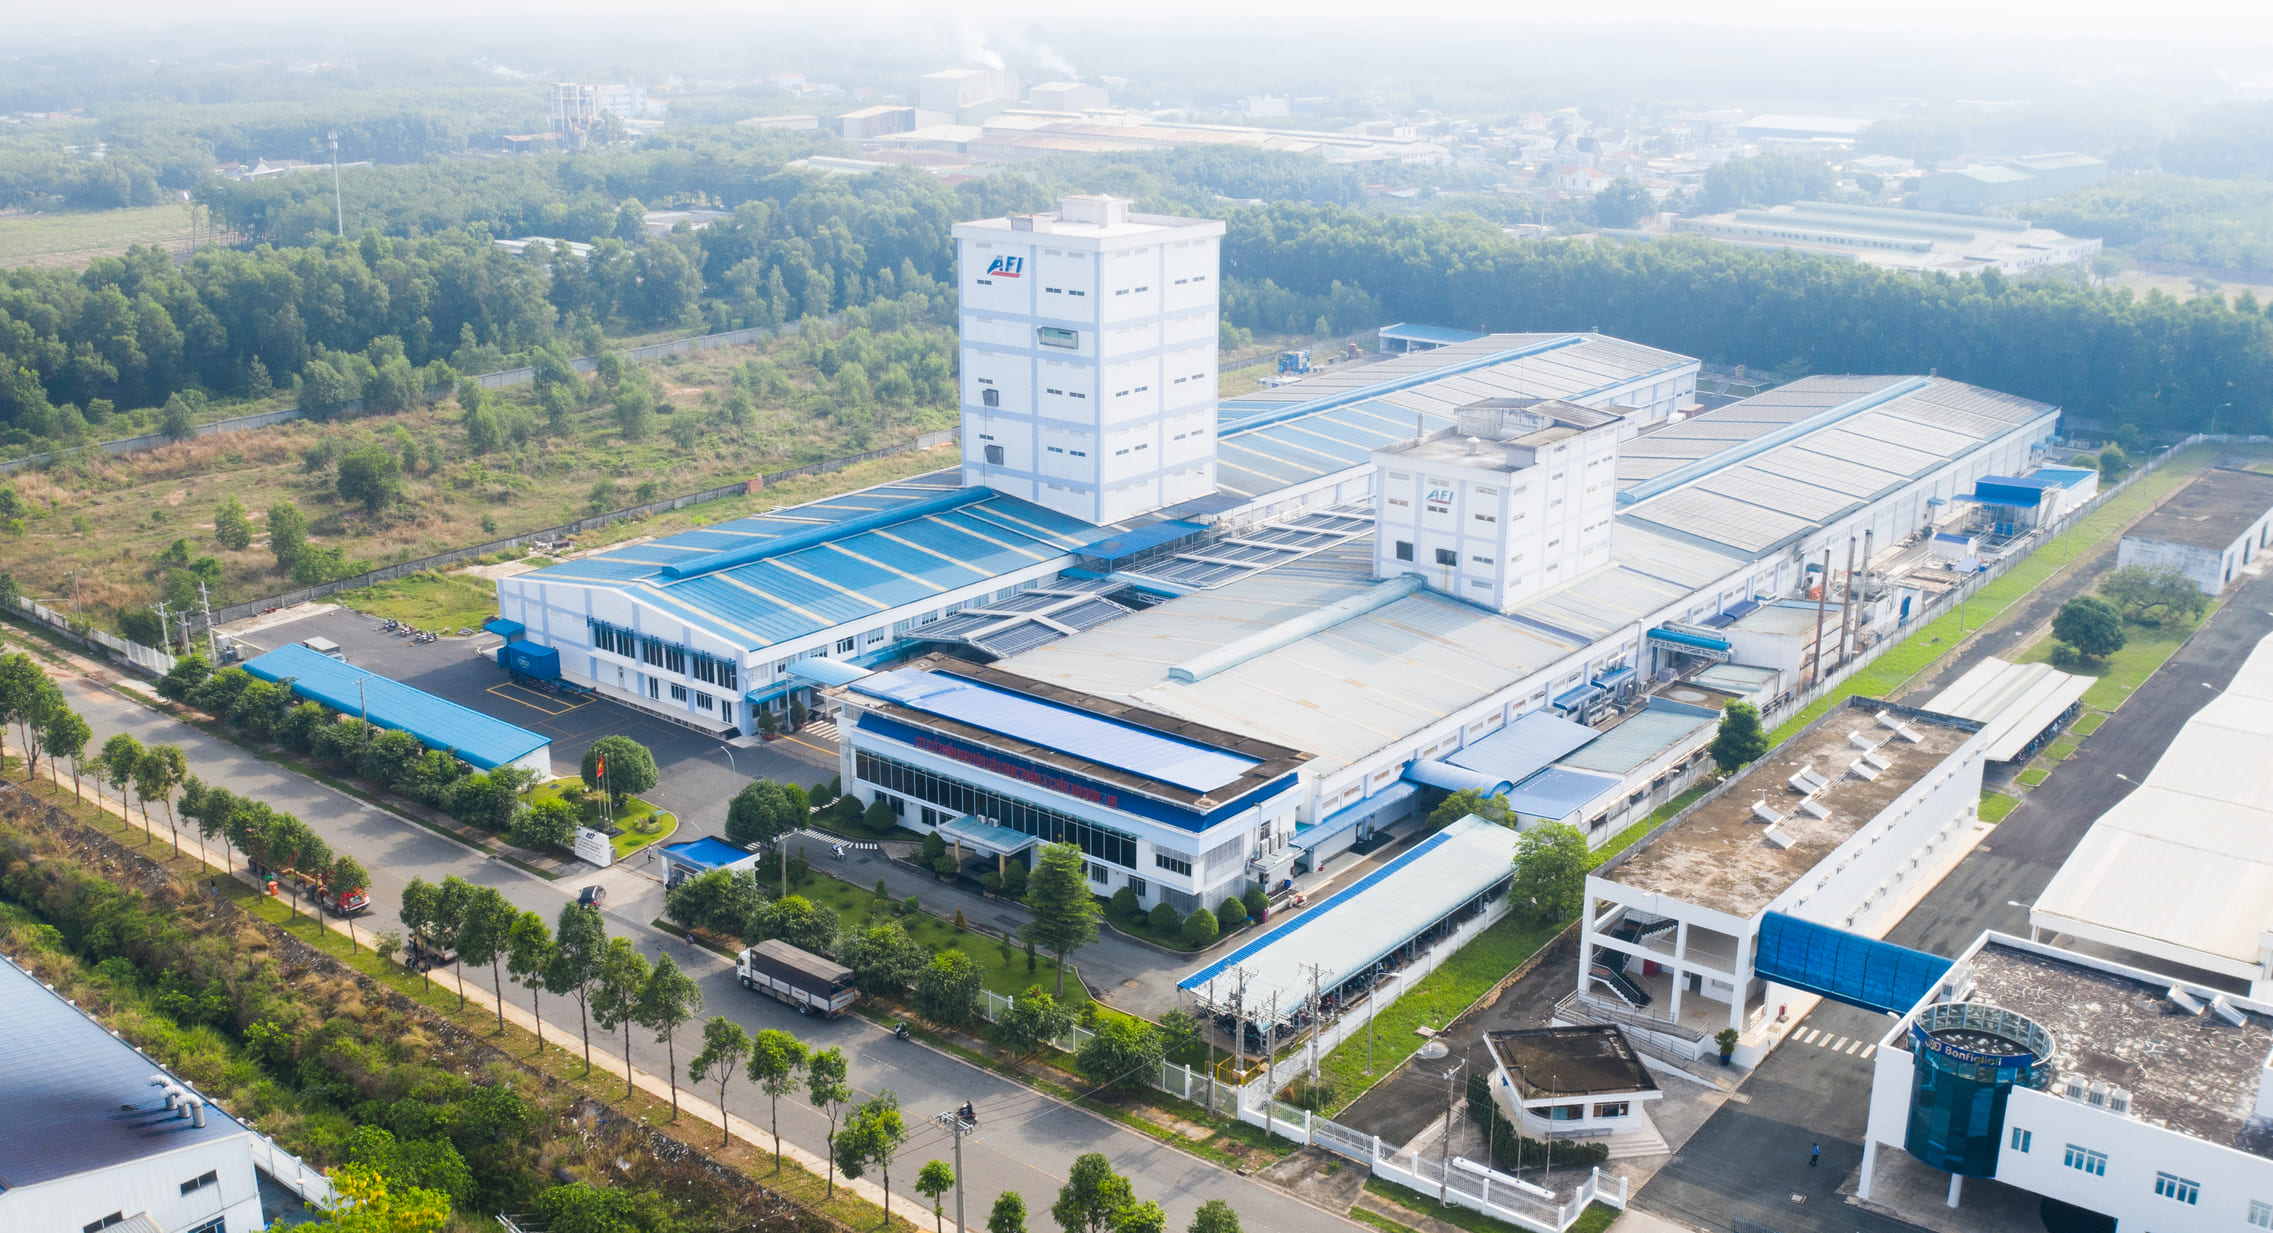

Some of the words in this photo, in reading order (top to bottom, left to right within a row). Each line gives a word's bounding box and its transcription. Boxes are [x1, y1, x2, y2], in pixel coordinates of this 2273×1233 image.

[987, 255, 1024, 274] AFI
[1426, 490, 1454, 502] AFI
[1945, 1046, 2001, 1066] Bonfiglioli
